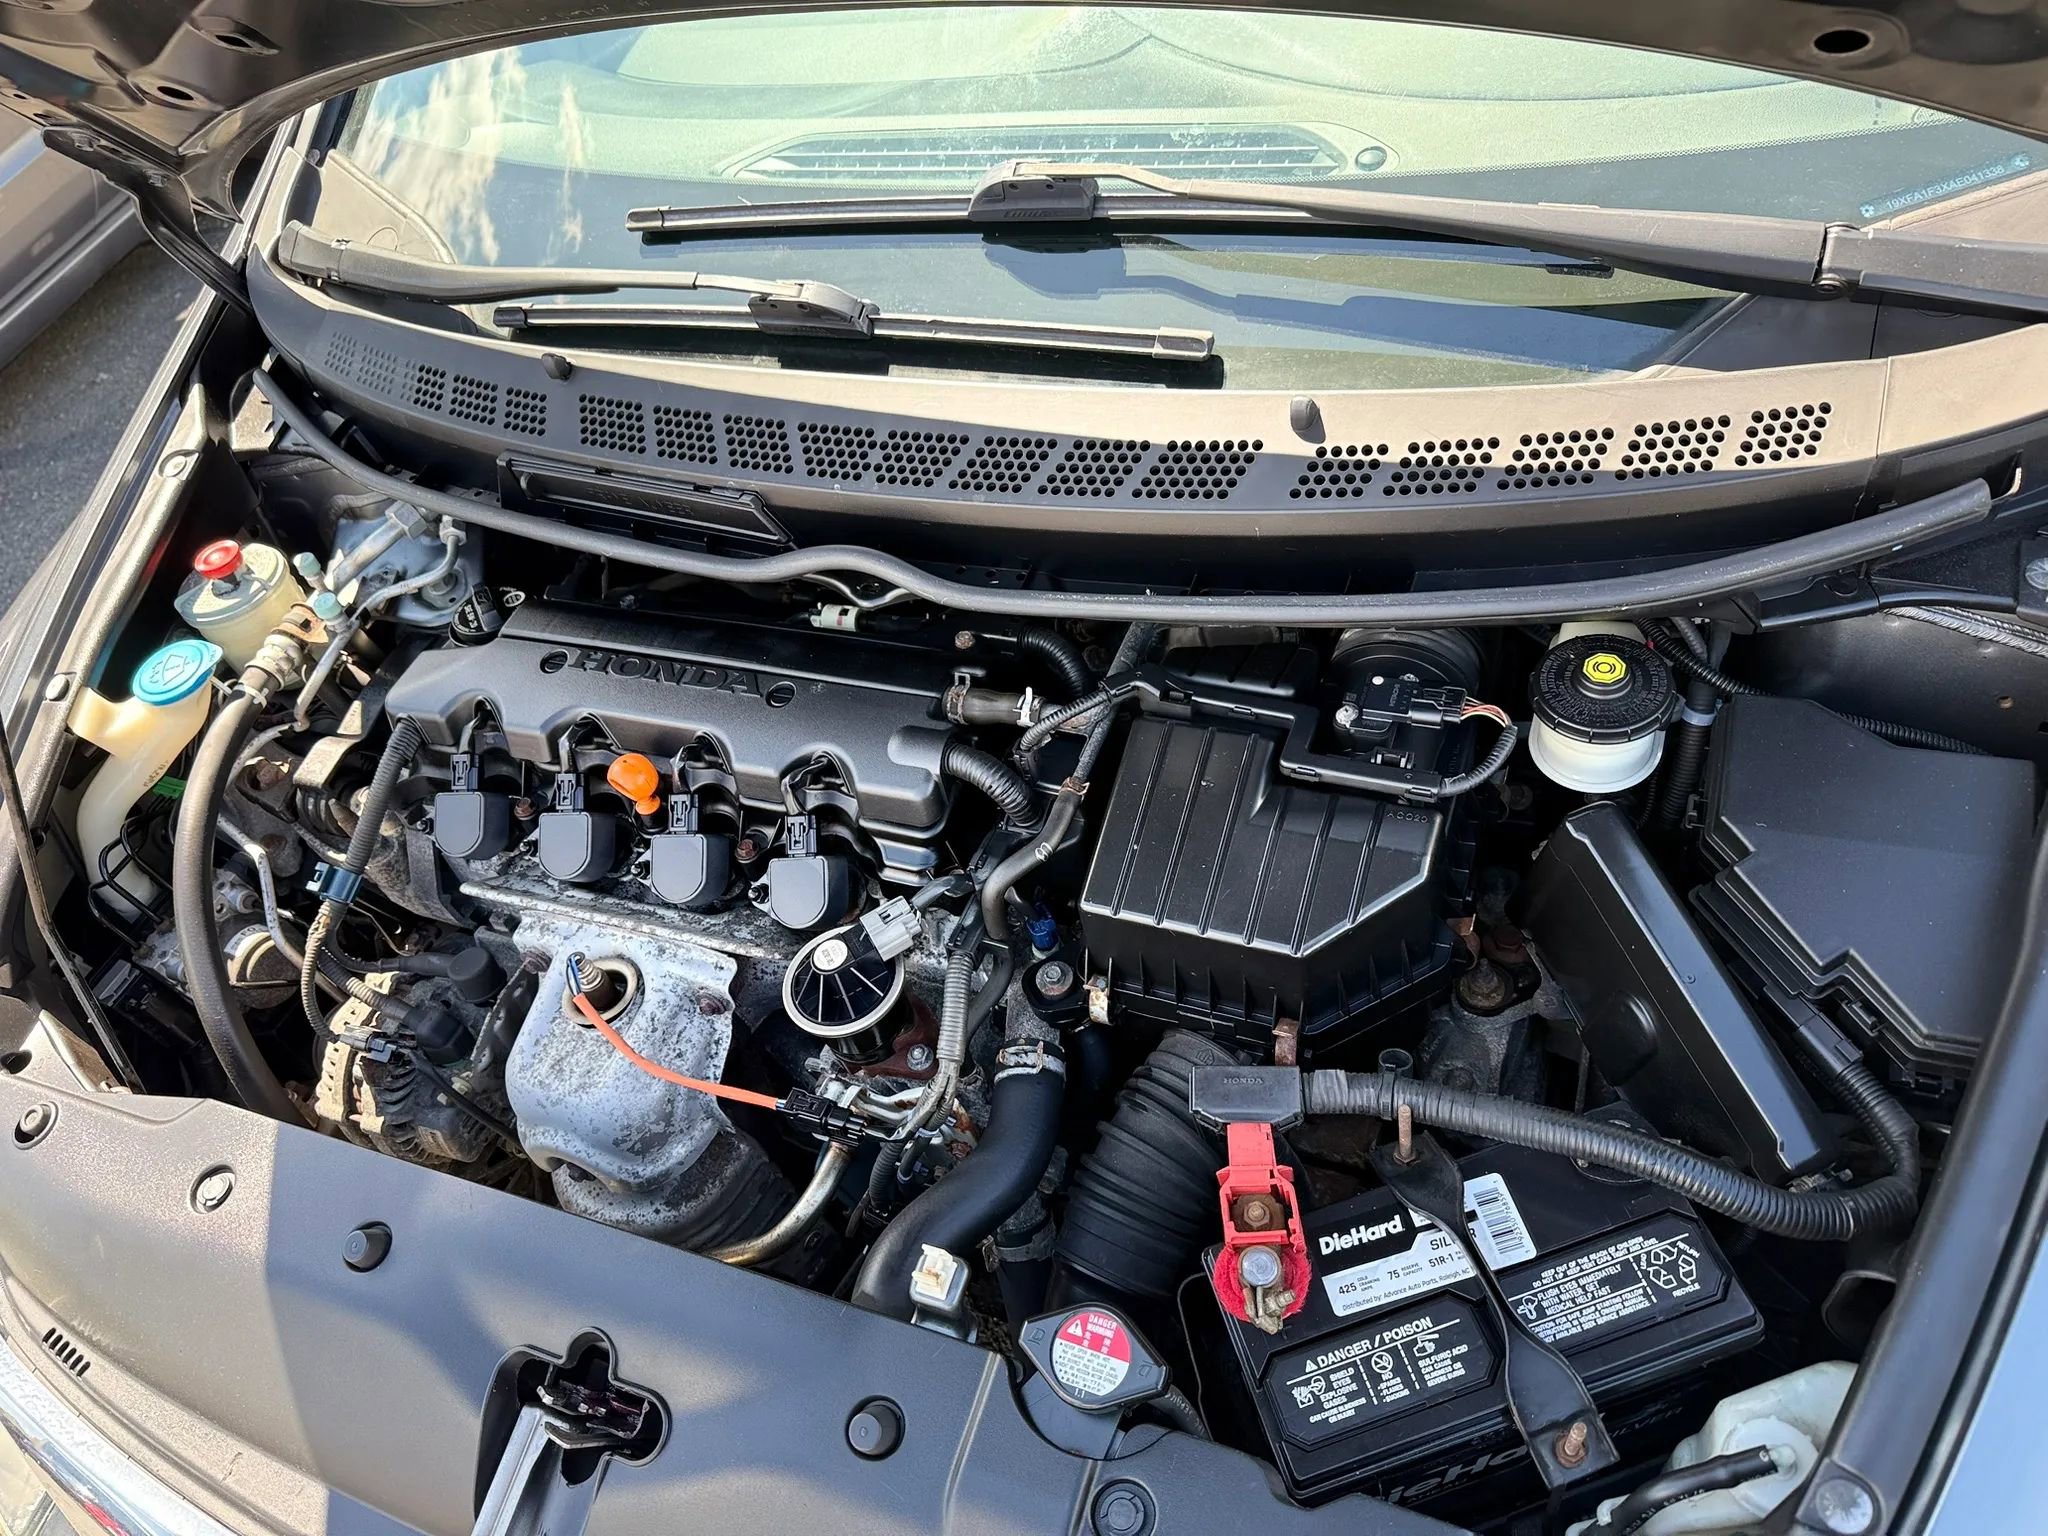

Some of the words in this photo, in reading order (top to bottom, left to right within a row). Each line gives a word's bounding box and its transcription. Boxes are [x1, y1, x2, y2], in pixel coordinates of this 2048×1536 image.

[1886, 164, 2005, 210] 19XFA1F3XAE041338
[568, 649, 762, 698] HONDA
[1223, 1077, 1264, 1085] HONDA
[1318, 1214, 1404, 1256] DieHard
[1428, 1253, 1455, 1268] 51R-1
[1387, 1269, 1401, 1281] 75
[1541, 1267, 1556, 1279] KEEP
[1555, 1263, 1568, 1273] OUT
[1338, 1282, 1358, 1296] 425
[1342, 1297, 1374, 1312] Distributed
[1383, 1287, 1407, 1299] Advance
[1407, 1283, 1422, 1292] Auto
[1461, 1267, 1471, 1276] NC
[1532, 1280, 1542, 1289] DO
[1542, 1276, 1554, 1285] NOT
[1536, 1286, 1561, 1301] FLUSH
[1560, 1280, 1579, 1293] EYES
[1577, 1263, 1622, 1286] IMMEDIATELY
[1671, 1282, 1701, 1299] RECYCLE
[1540, 1295, 1560, 1308] WITH
[1585, 1281, 1600, 1292] GET
[1544, 1300, 1575, 1316] MEDICAL
[1574, 1291, 1593, 1305] HELP
[1594, 1285, 1612, 1298] FAST
[1088, 1313, 1118, 1331] DANGER
[1317, 1339, 1371, 1369] DANGER
[1383, 1316, 1434, 1344] POISON
[1418, 1350, 1452, 1368] SULFURIC
[1452, 1344, 1468, 1356] ACID
[1329, 1367, 1355, 1382] SHIELD
[1332, 1376, 1352, 1390] EYES
[1381, 1371, 1394, 1381] NO
[1320, 1382, 1359, 1402] EXPLOSIVE
[1323, 1395, 1348, 1410] GASES
